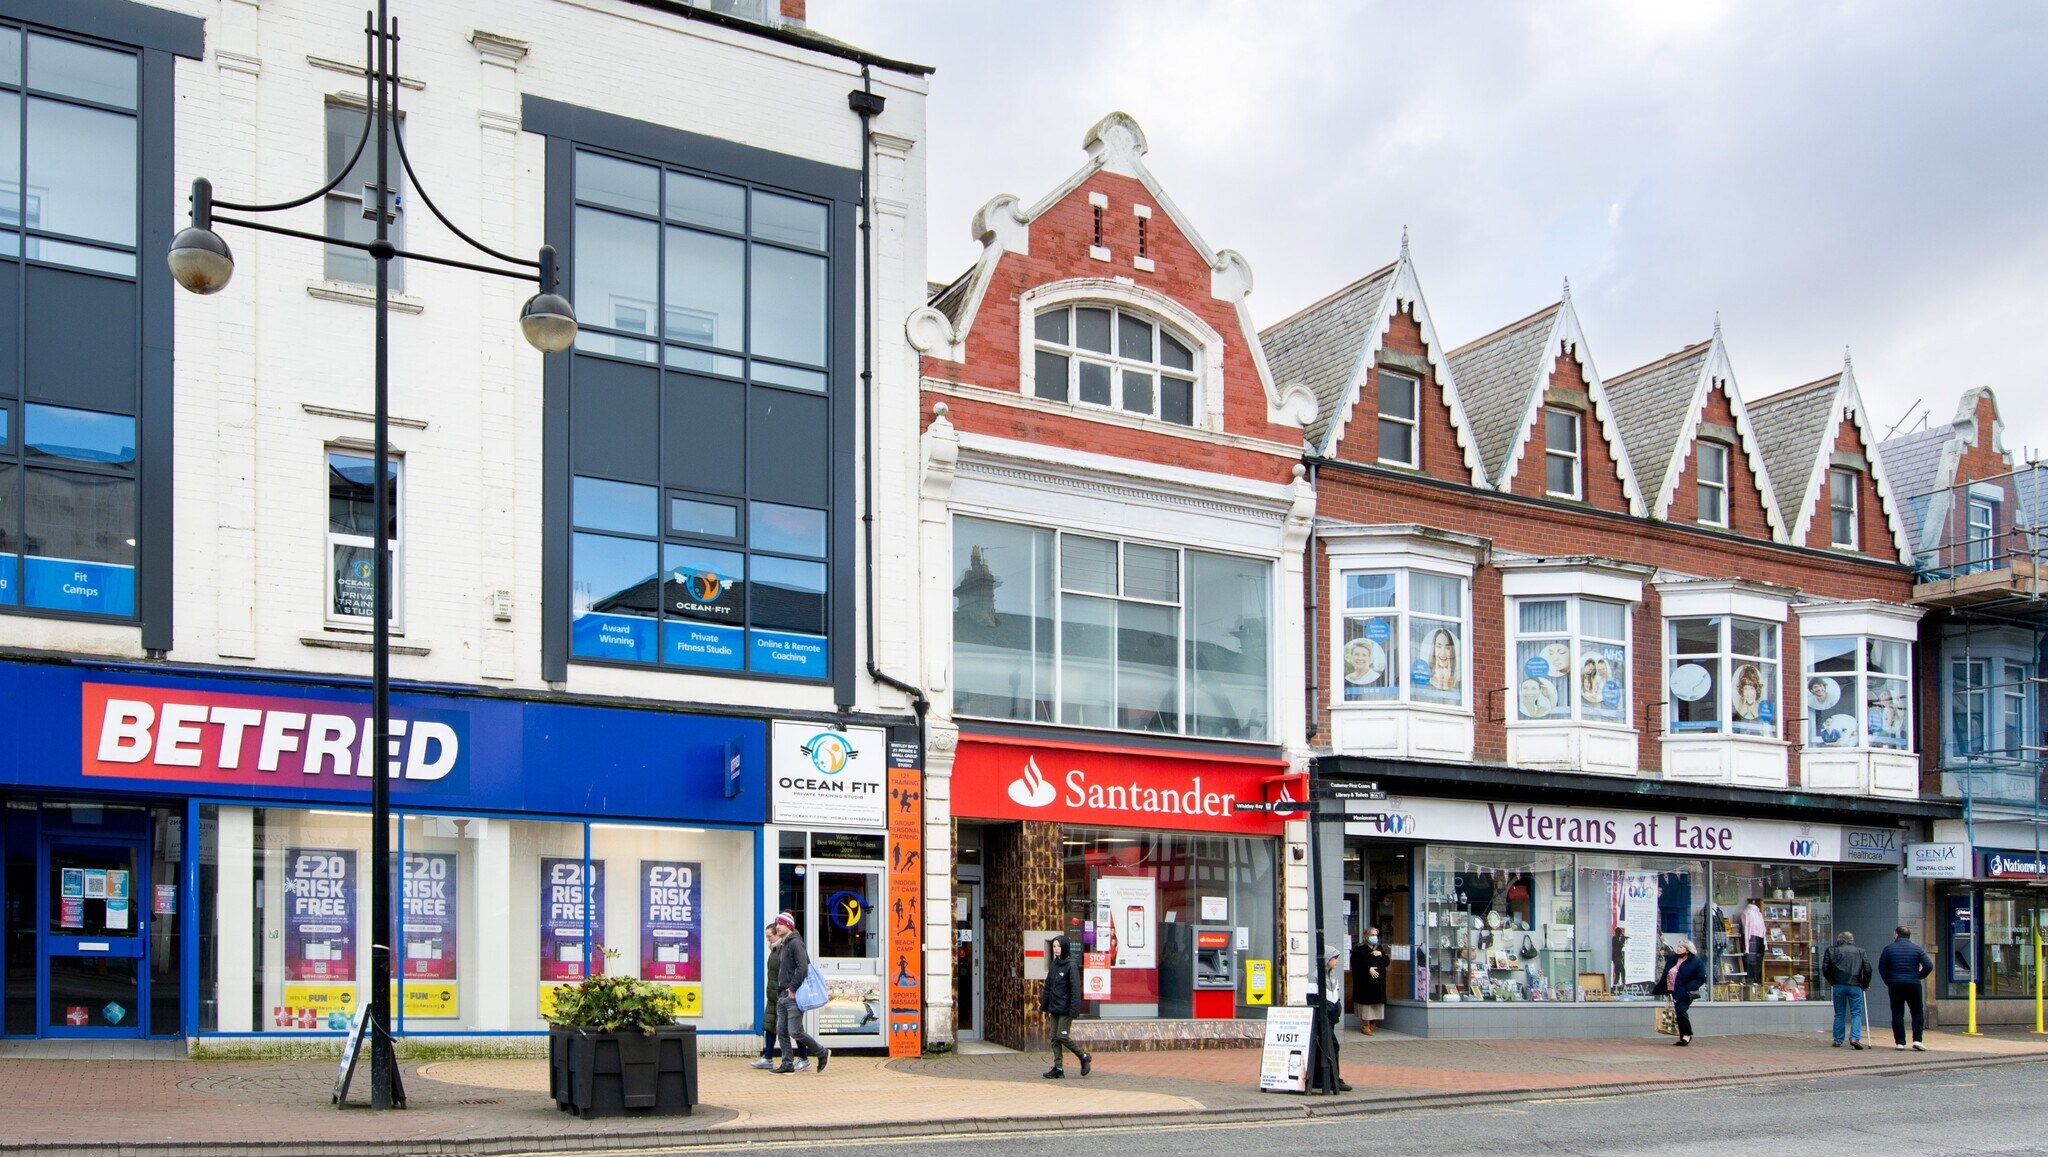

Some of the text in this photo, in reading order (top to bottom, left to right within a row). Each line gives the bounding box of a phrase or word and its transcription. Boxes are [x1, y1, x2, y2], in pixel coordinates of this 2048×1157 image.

[74, 572, 88, 582] Fit
[338, 578, 374, 587] OCEAN-
[62, 584, 98, 598] Camps
[342, 592, 374, 600] PRIVA
[338, 598, 374, 608] TRAINI
[344, 606, 374, 616] STUD
[602, 624, 630, 634] Award
[600, 634, 634, 648] Winning
[691, 632, 719, 643] Private
[678, 642, 732, 655] Fitness Studio
[757, 638, 820, 652] Online & Remote
[772, 651, 806, 664] Coaching
[1604, 648, 1624, 660] NHS
[97, 698, 459, 781] BETFRED
[1065, 770, 1235, 816] Santander
[1487, 802, 1732, 850] Veterans at Ease
[1848, 850, 1882, 860] Healthcare
[295, 856, 345, 879] £20
[551, 864, 596, 885] £20
[650, 866, 692, 888] £20
[296, 879, 344, 898] RISK
[403, 880, 445, 898] RISK
[552, 886, 595, 903] RISK
[651, 888, 691, 906] RISK
[296, 898, 346, 915] FREE
[650, 905, 692, 921] FREE
[1089, 954, 1105, 962] STOP
[410, 992, 428, 1000] FUN
[1276, 1034, 1299, 1042] VISIT
